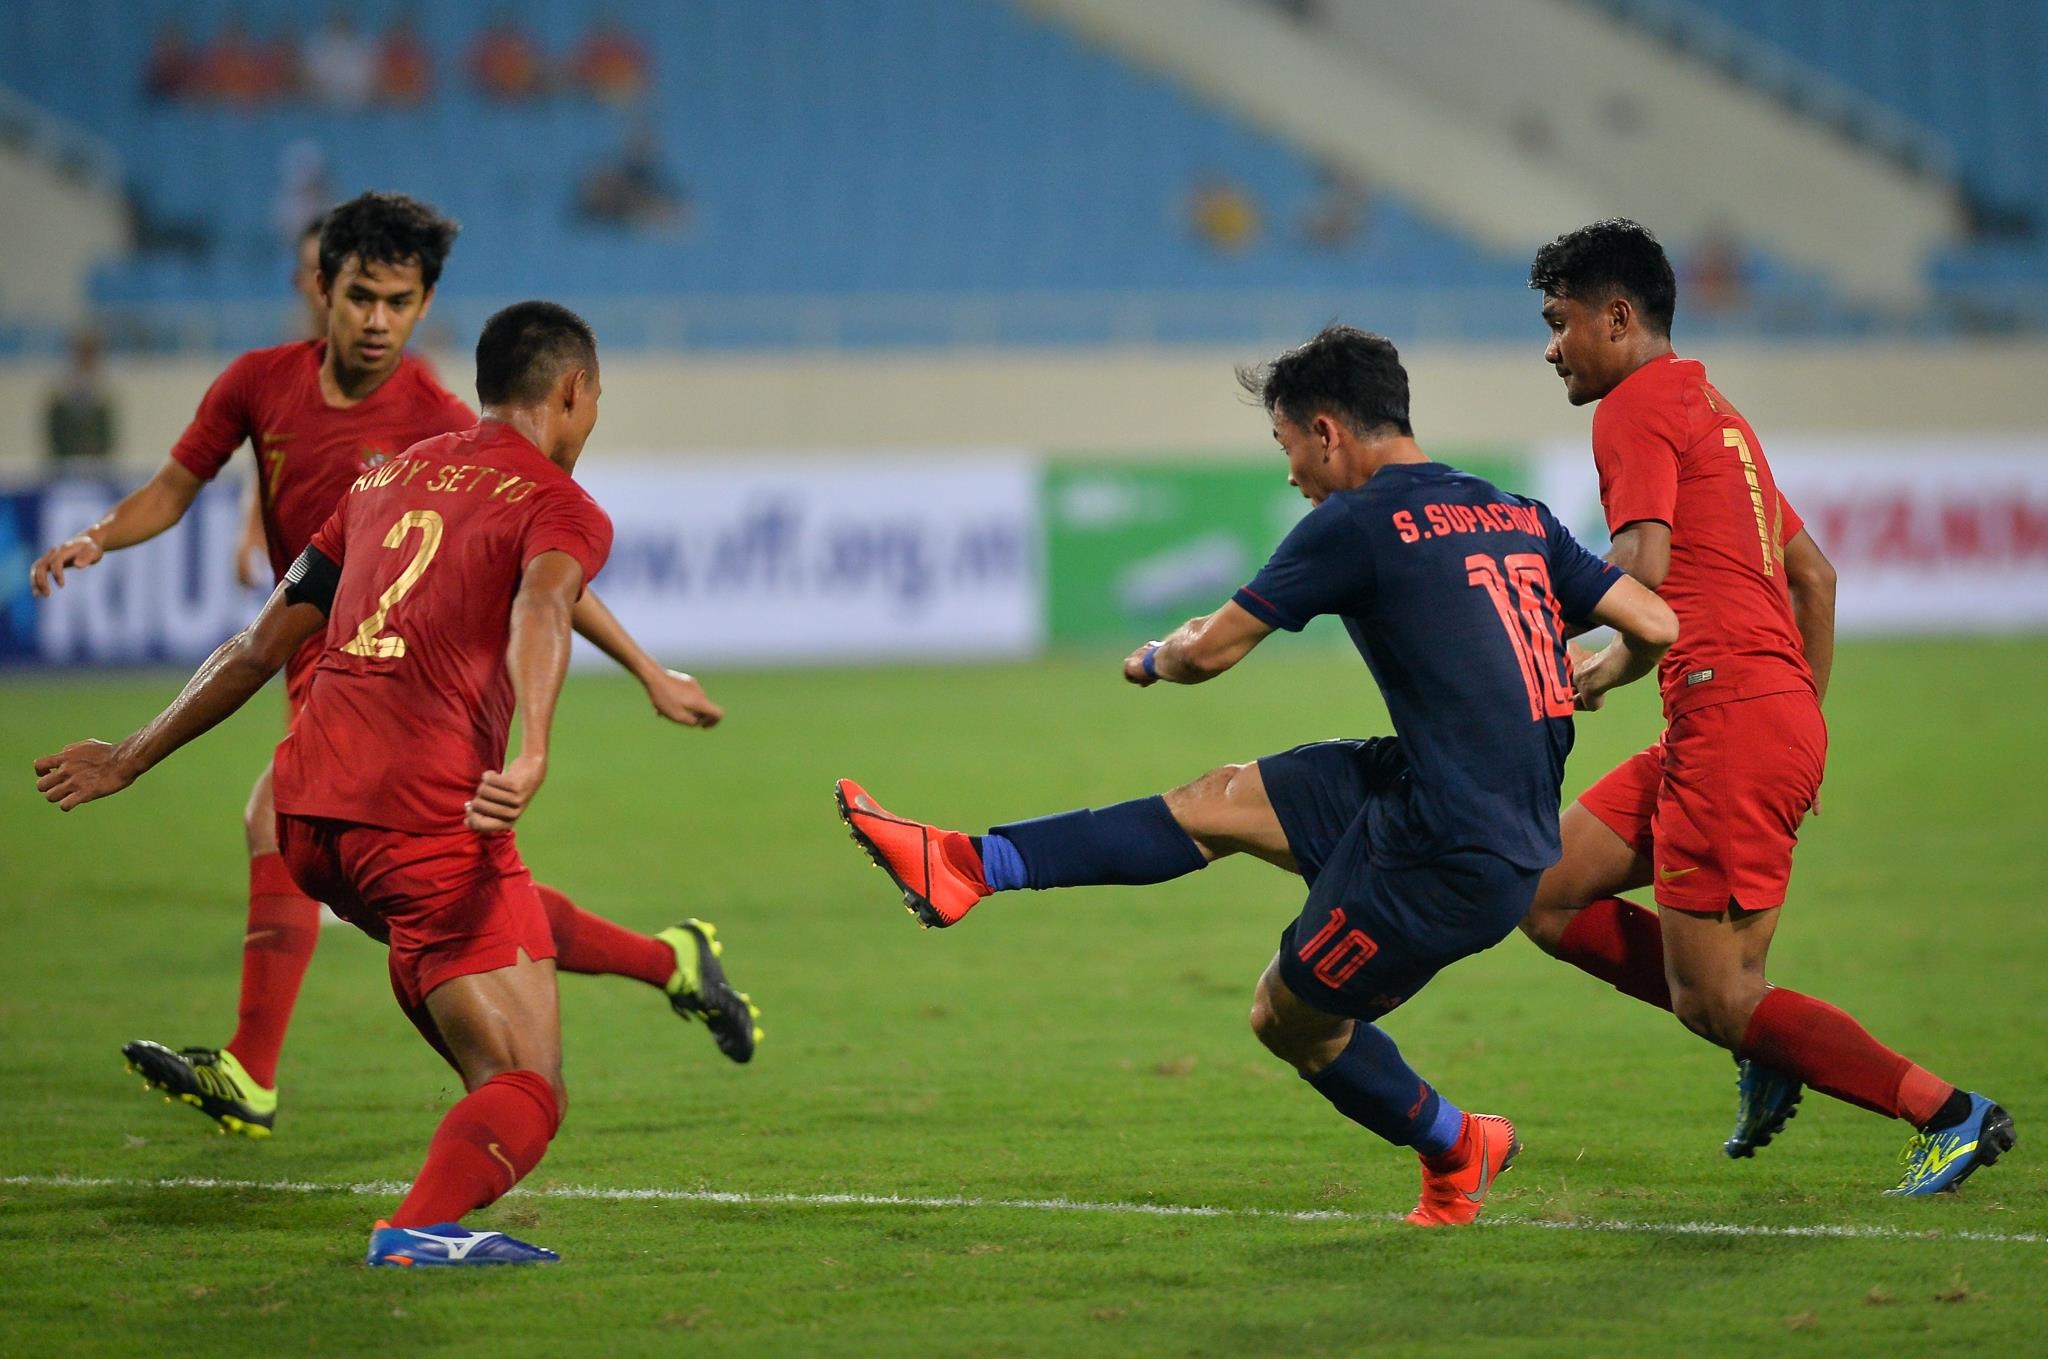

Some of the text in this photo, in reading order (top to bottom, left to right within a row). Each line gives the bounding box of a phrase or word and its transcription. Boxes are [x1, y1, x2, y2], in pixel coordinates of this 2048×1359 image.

[350, 459, 537, 504] ANDY SETYO
[339, 510, 444, 658] 2
[1465, 553, 1575, 722] 10
[1298, 907, 1379, 990] 10
